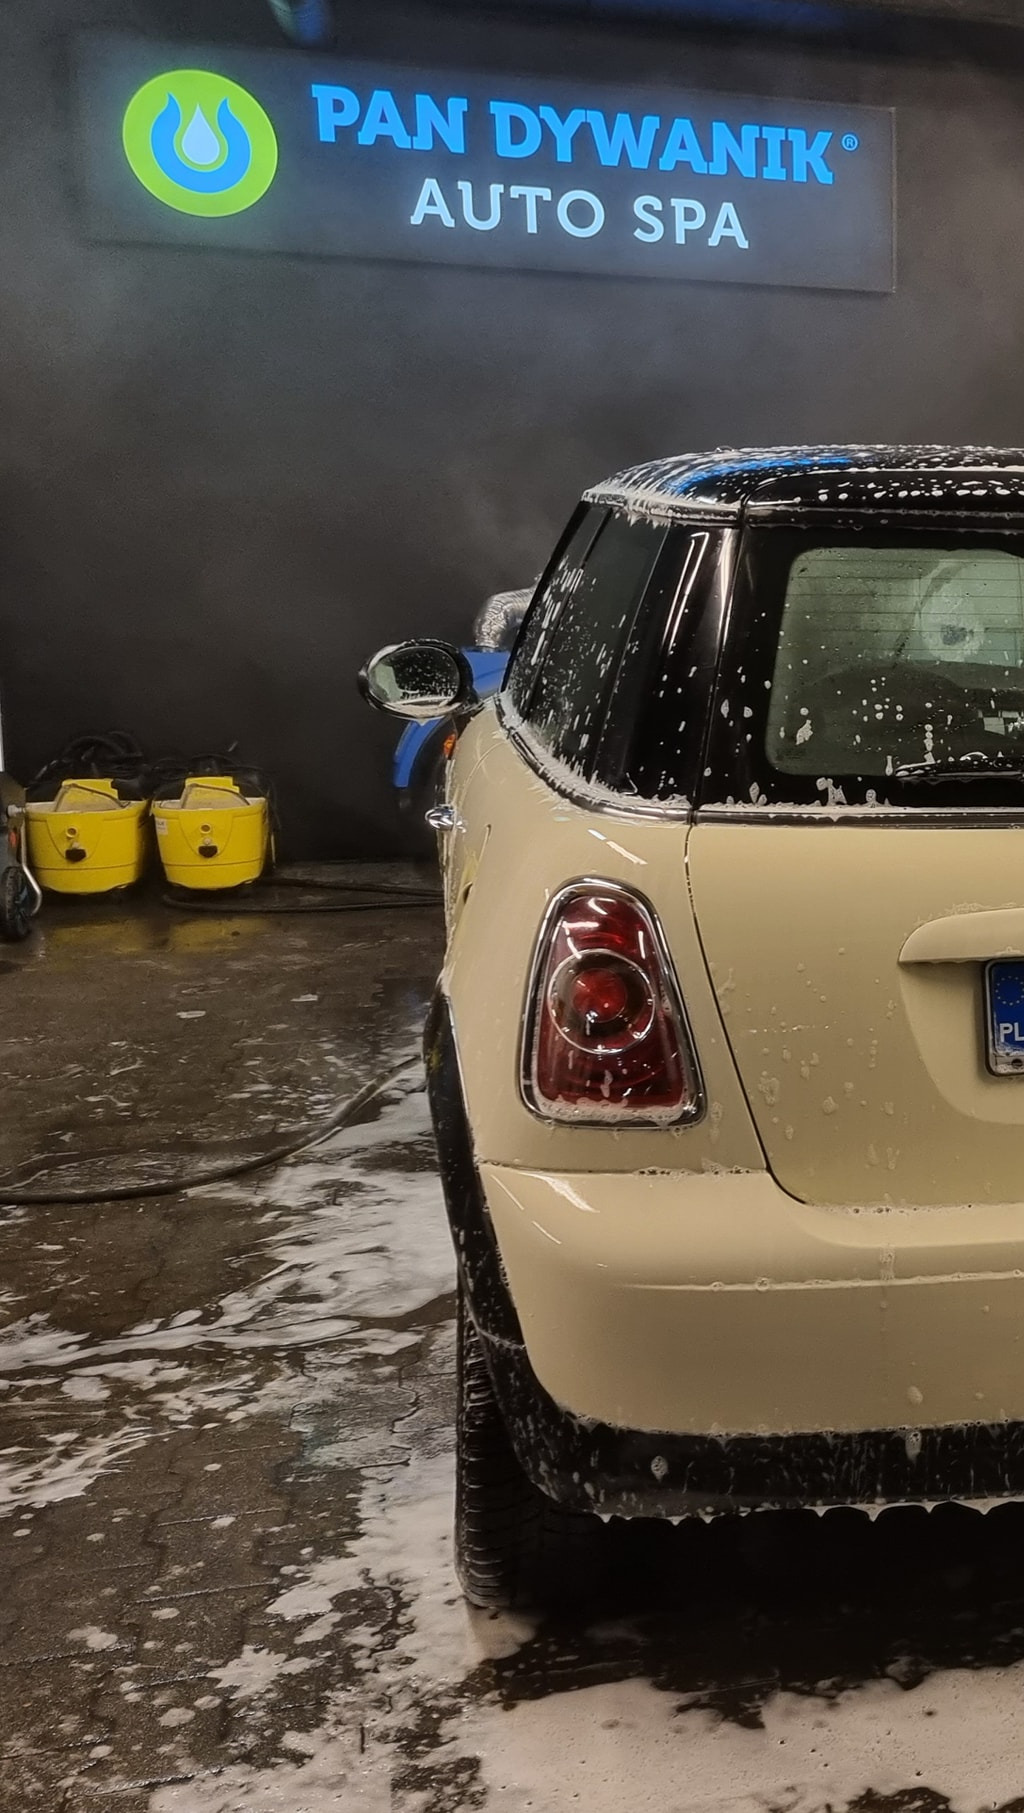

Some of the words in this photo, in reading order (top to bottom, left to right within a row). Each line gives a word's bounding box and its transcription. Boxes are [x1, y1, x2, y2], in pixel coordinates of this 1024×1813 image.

[310, 83, 468, 154] PAN
[409, 177, 606, 239] AUTO
[632, 194, 750, 250] SPA
